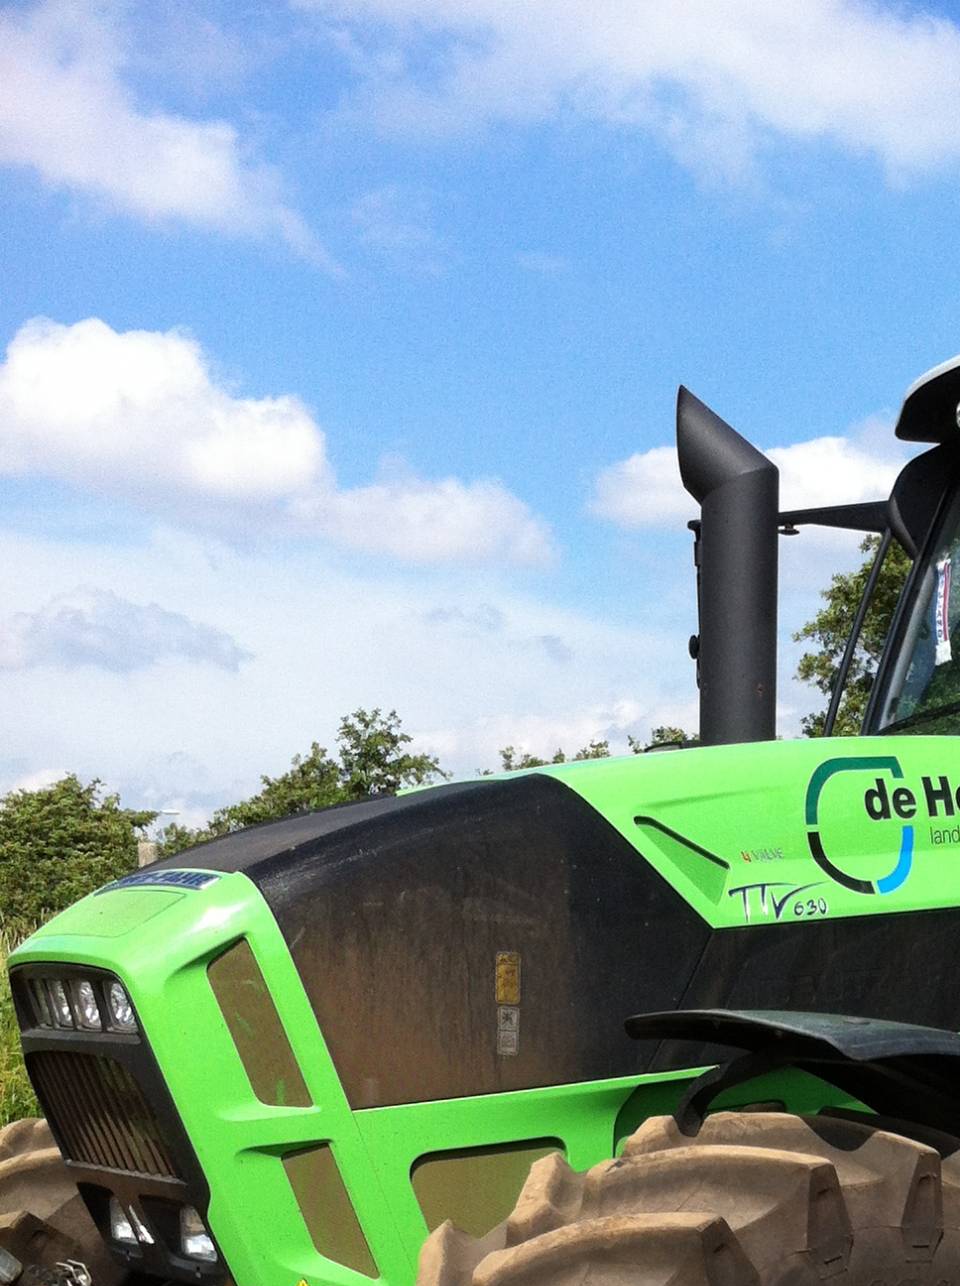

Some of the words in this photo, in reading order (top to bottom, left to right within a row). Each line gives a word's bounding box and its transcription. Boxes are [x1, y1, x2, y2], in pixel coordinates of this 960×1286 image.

[864, 778, 917, 821] de
[929, 825, 960, 845] land
[728, 881, 831, 923] TTV
[794, 897, 827, 916] 630
